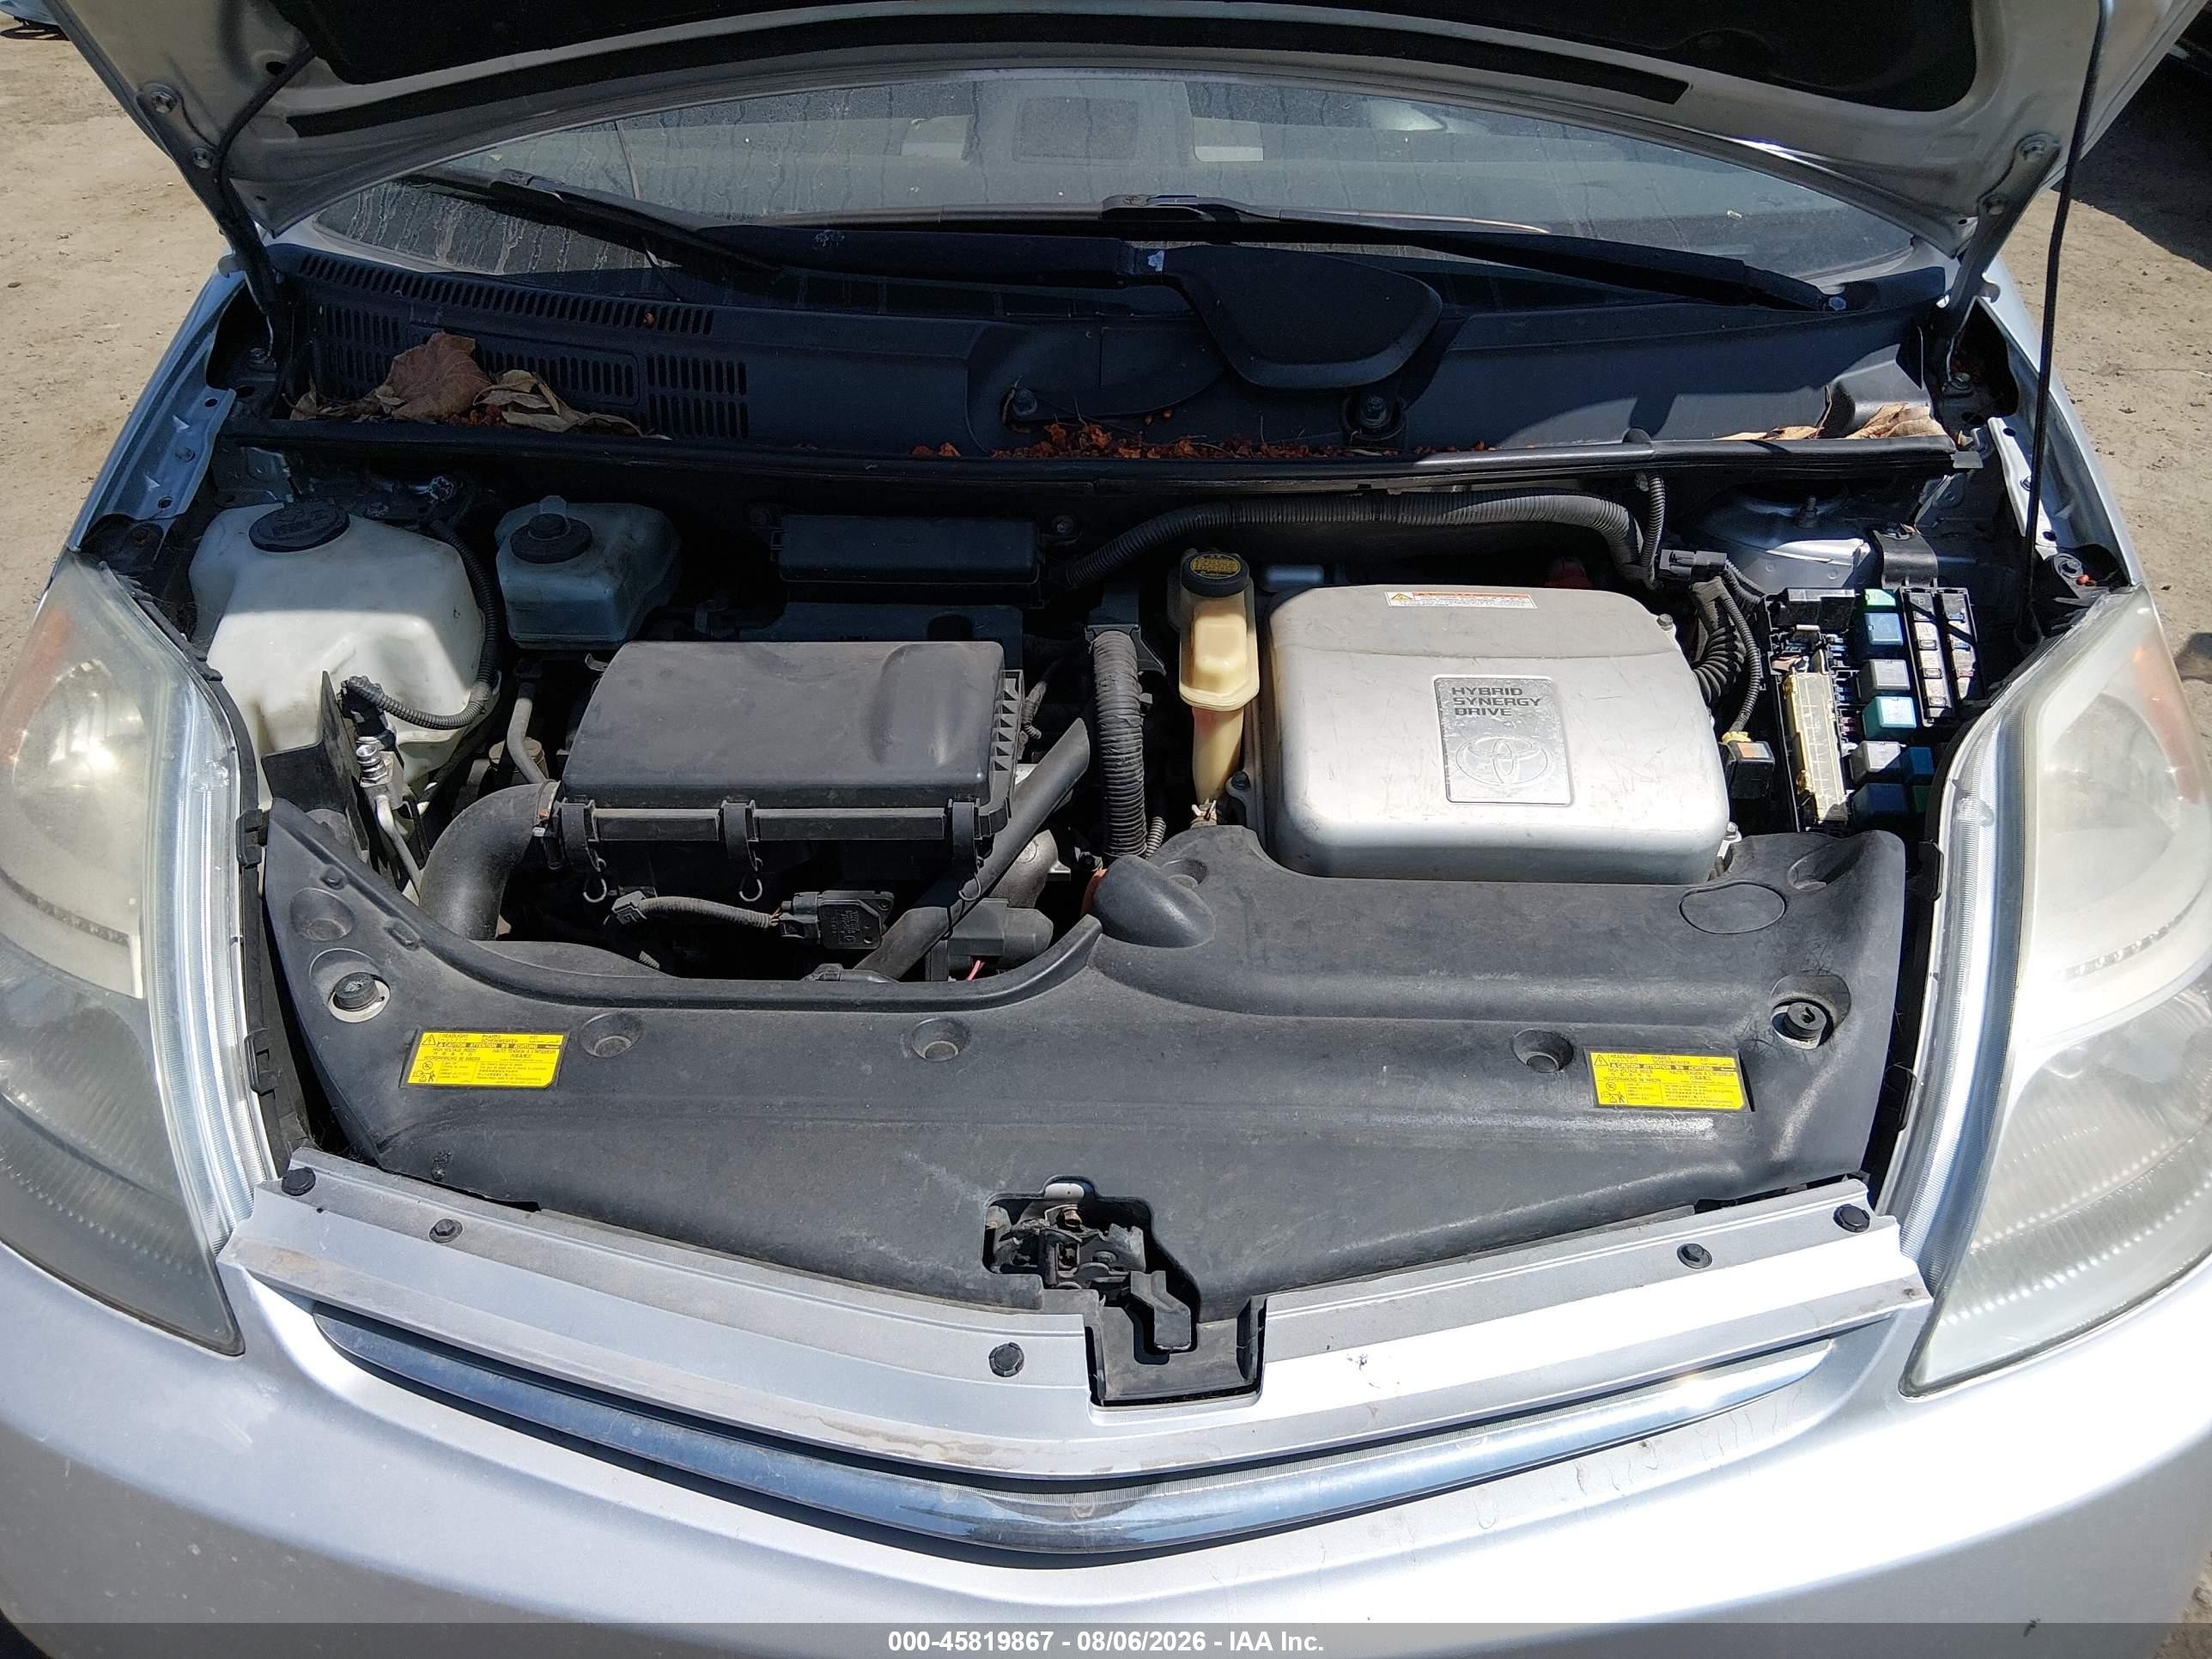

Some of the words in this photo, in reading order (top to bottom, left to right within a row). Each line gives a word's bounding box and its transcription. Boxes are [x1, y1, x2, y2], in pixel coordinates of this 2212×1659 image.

[1451, 686, 1522, 696] HYBRID
[1453, 697, 1541, 706] SYNERGY
[1455, 708, 1512, 716] DRIVE
